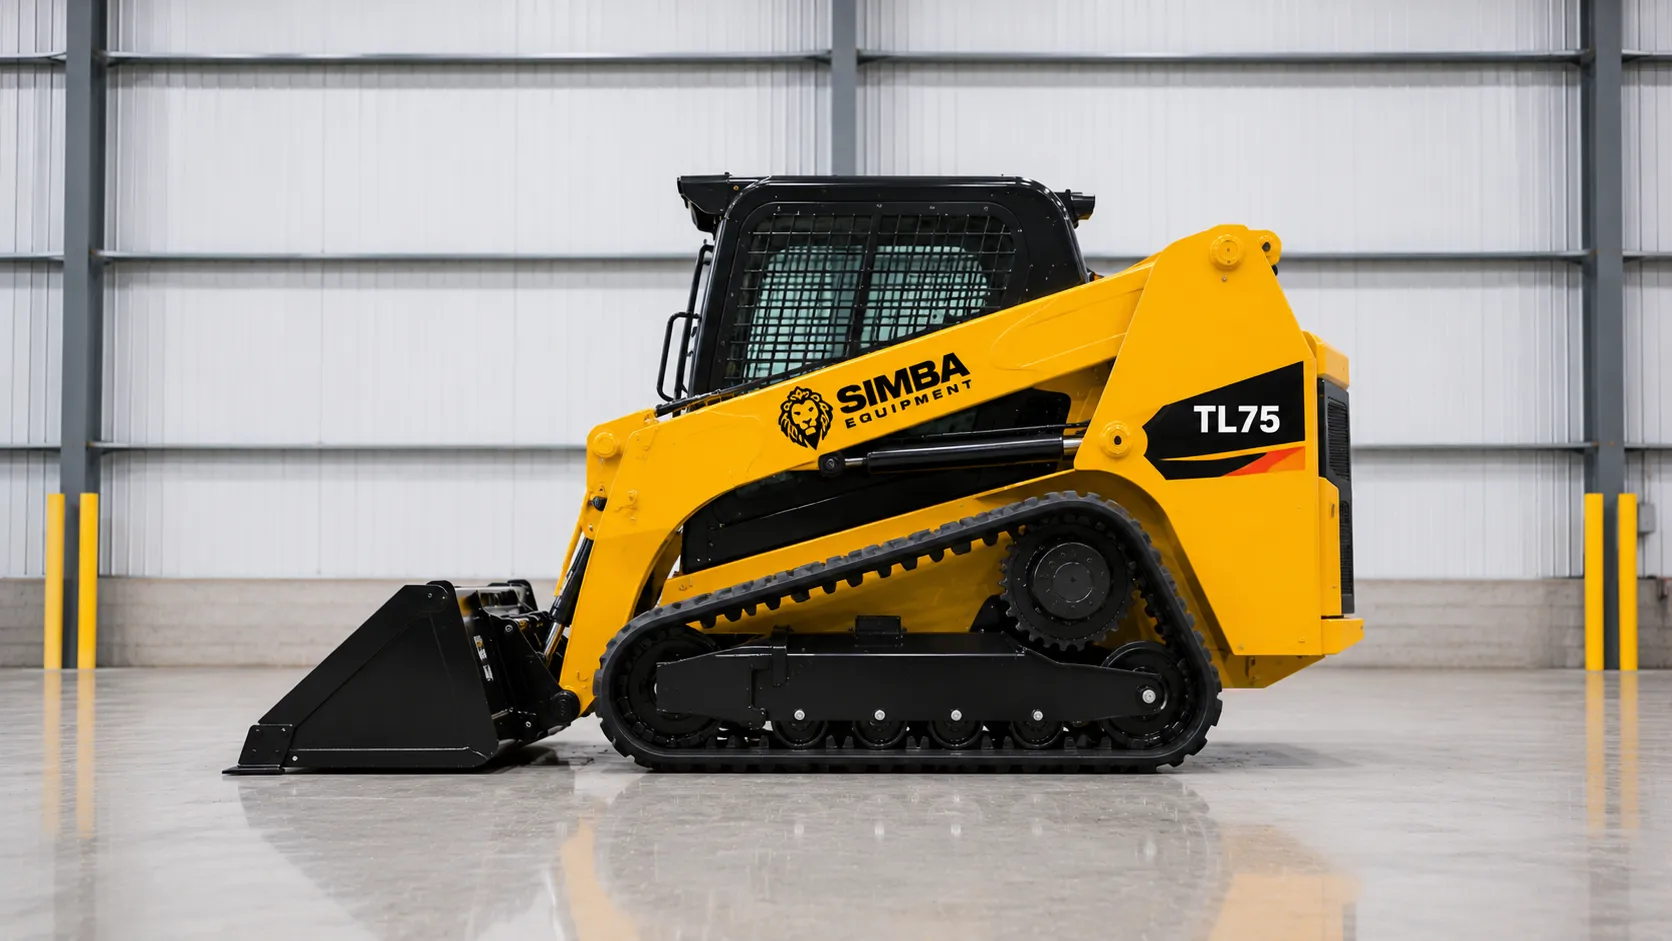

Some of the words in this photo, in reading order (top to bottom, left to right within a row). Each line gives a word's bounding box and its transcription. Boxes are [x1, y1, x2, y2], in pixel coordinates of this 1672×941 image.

[837, 352, 970, 414] SIMBA
[844, 379, 972, 429] EQUIPMENT
[1193, 405, 1281, 434] TL75
